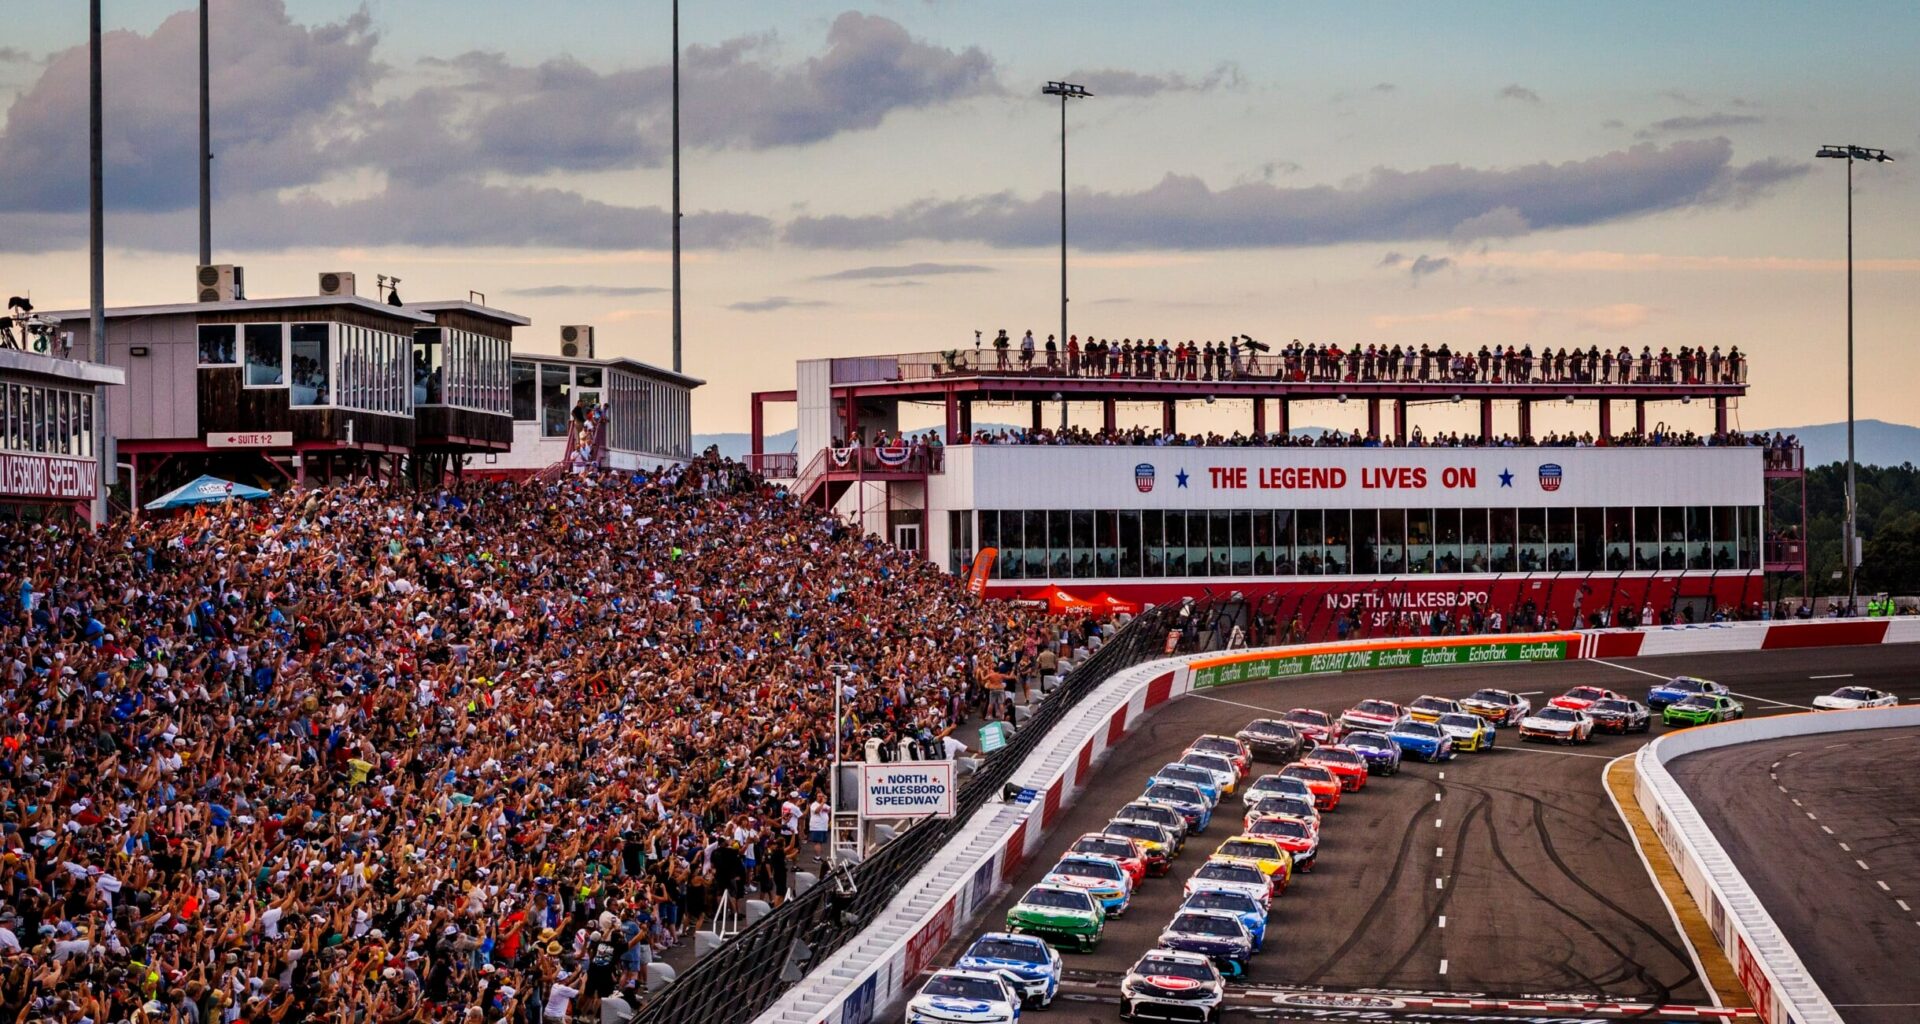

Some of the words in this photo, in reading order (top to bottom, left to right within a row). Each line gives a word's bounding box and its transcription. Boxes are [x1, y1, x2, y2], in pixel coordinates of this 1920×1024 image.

[238, 435, 258, 444] SUITE
[260, 435, 273, 444] 1-2
[0, 454, 48, 495] LKESBORO
[49, 458, 97, 497] SPEEDWAY
[1208, 467, 1248, 489] THE
[1259, 467, 1347, 489] LEGEND
[1361, 467, 1427, 489] LIVES
[1442, 467, 1476, 488] ON
[1247, 659, 1271, 679] EchoPark
[1278, 656, 1303, 675] EchoPark
[1309, 653, 1348, 671] RESTART
[1347, 650, 1373, 669] ZONE
[1378, 648, 1412, 667] EchoPark
[1421, 646, 1457, 664] EchoPark
[1469, 643, 1507, 662] EchoPark
[1519, 640, 1559, 660] EchoPark
[887, 774, 928, 784] NORTH
[870, 784, 945, 795] WILKESBORO
[875, 795, 940, 806] SPEEDWAY
